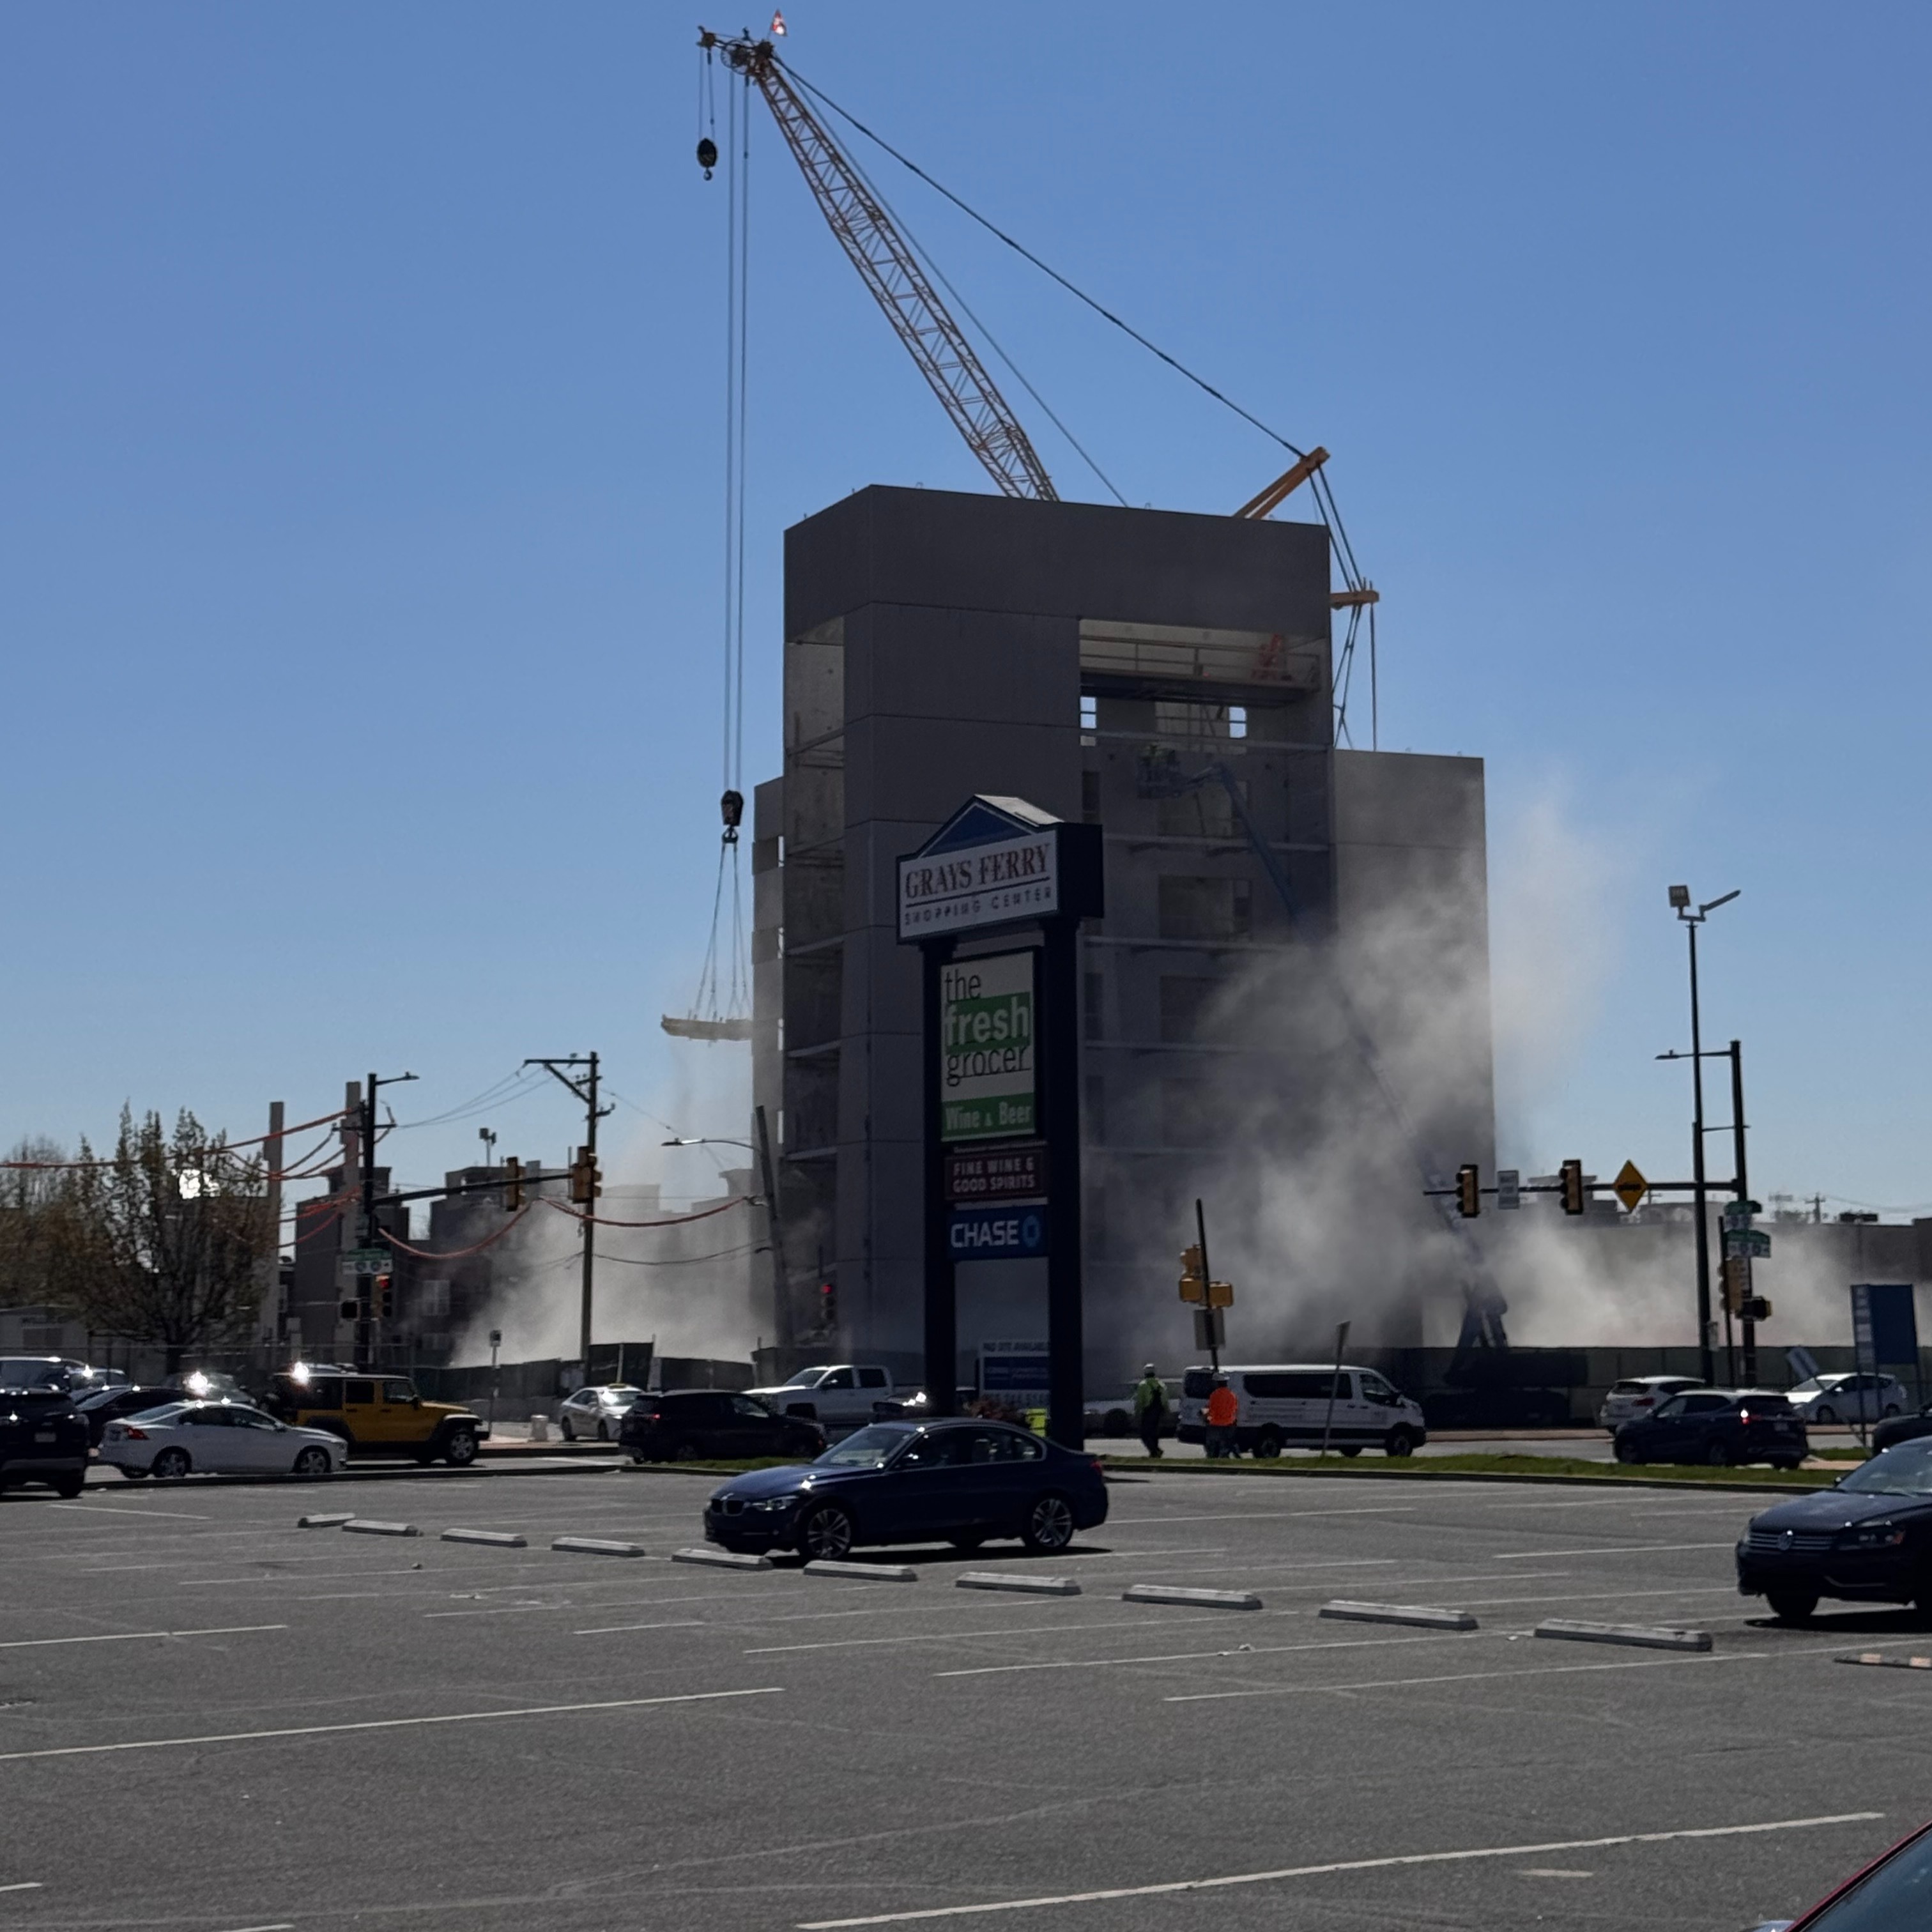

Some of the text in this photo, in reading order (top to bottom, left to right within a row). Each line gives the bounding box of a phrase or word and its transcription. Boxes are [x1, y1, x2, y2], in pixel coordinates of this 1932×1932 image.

[906, 843, 1050, 899] GRAYS FERRY
[905, 886, 1052, 926] SHOPPING CENTER
[945, 969, 981, 1003] the
[945, 996, 1030, 1046] fresh
[946, 1045, 1031, 1087] grocer
[999, 1101, 1031, 1125] Beer
[953, 1161, 983, 1176] FINE
[987, 1157, 1022, 1174] WINE
[953, 1174, 1035, 1193] GOOD SPIRITS
[950, 1220, 1020, 1248] CHASE
